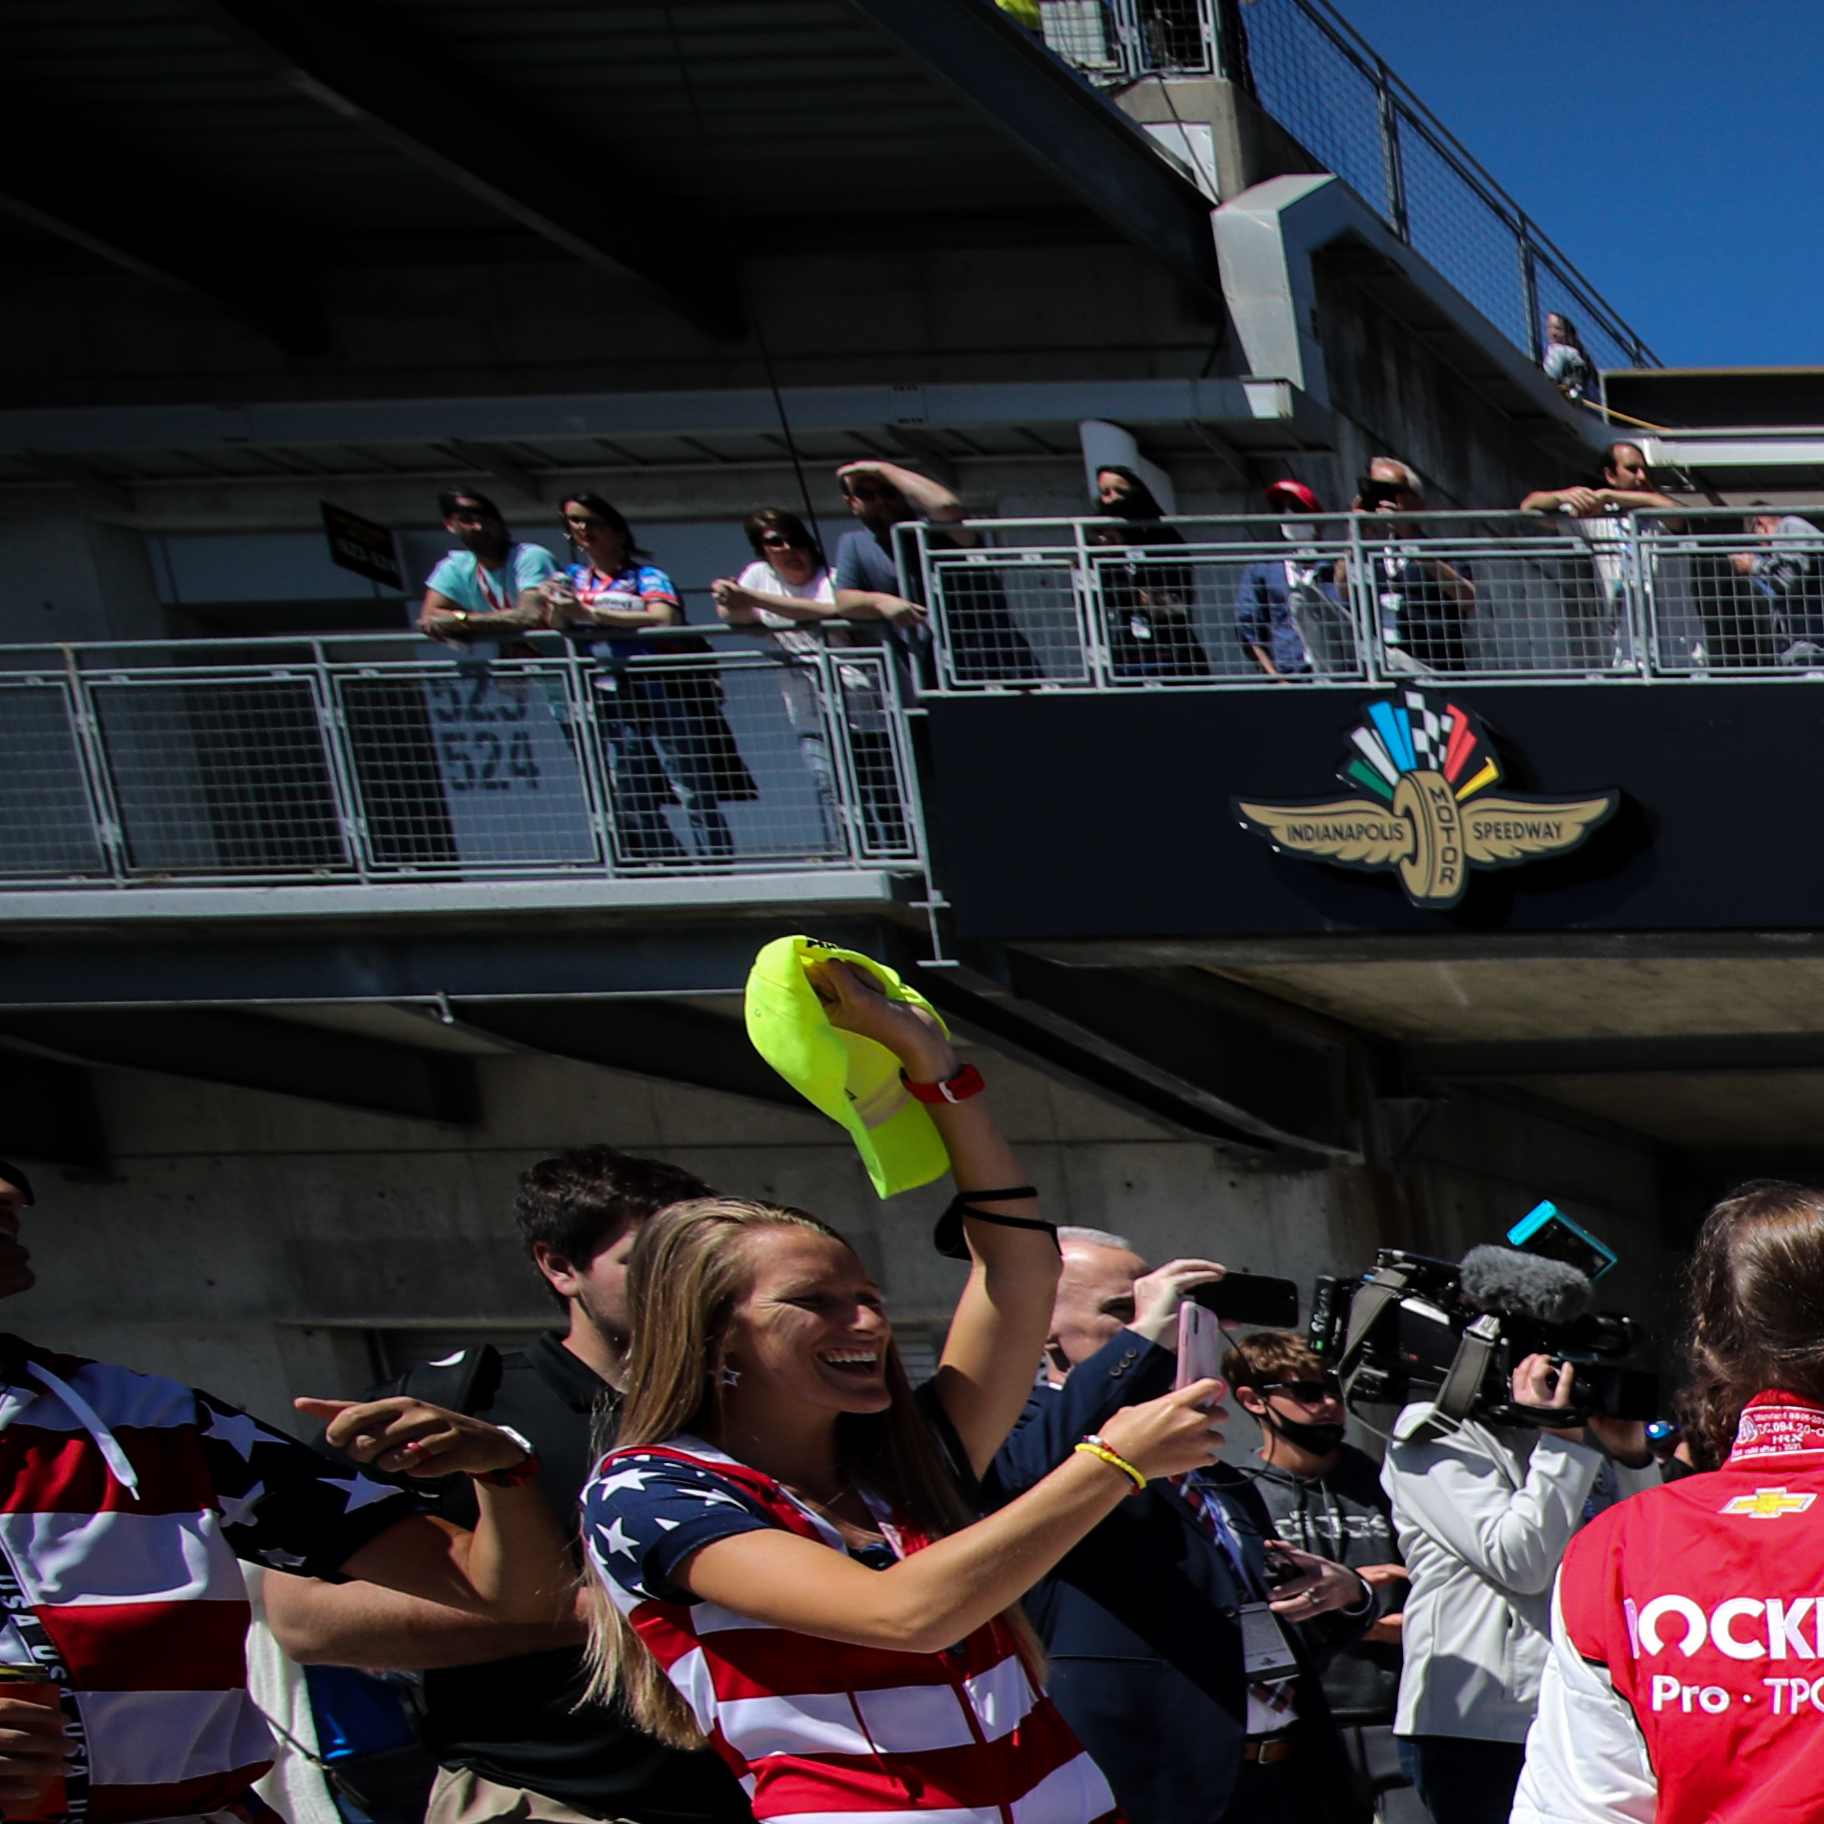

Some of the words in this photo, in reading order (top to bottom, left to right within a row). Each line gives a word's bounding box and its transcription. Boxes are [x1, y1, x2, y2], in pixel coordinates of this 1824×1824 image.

[446, 729, 540, 791] 524
[1285, 818, 1406, 848] INDIANAPOLIS
[1429, 785, 1458, 887] MOTOR
[1471, 818, 1564, 844] SPEEDWAY
[1653, 1676, 1730, 1714] Pro
